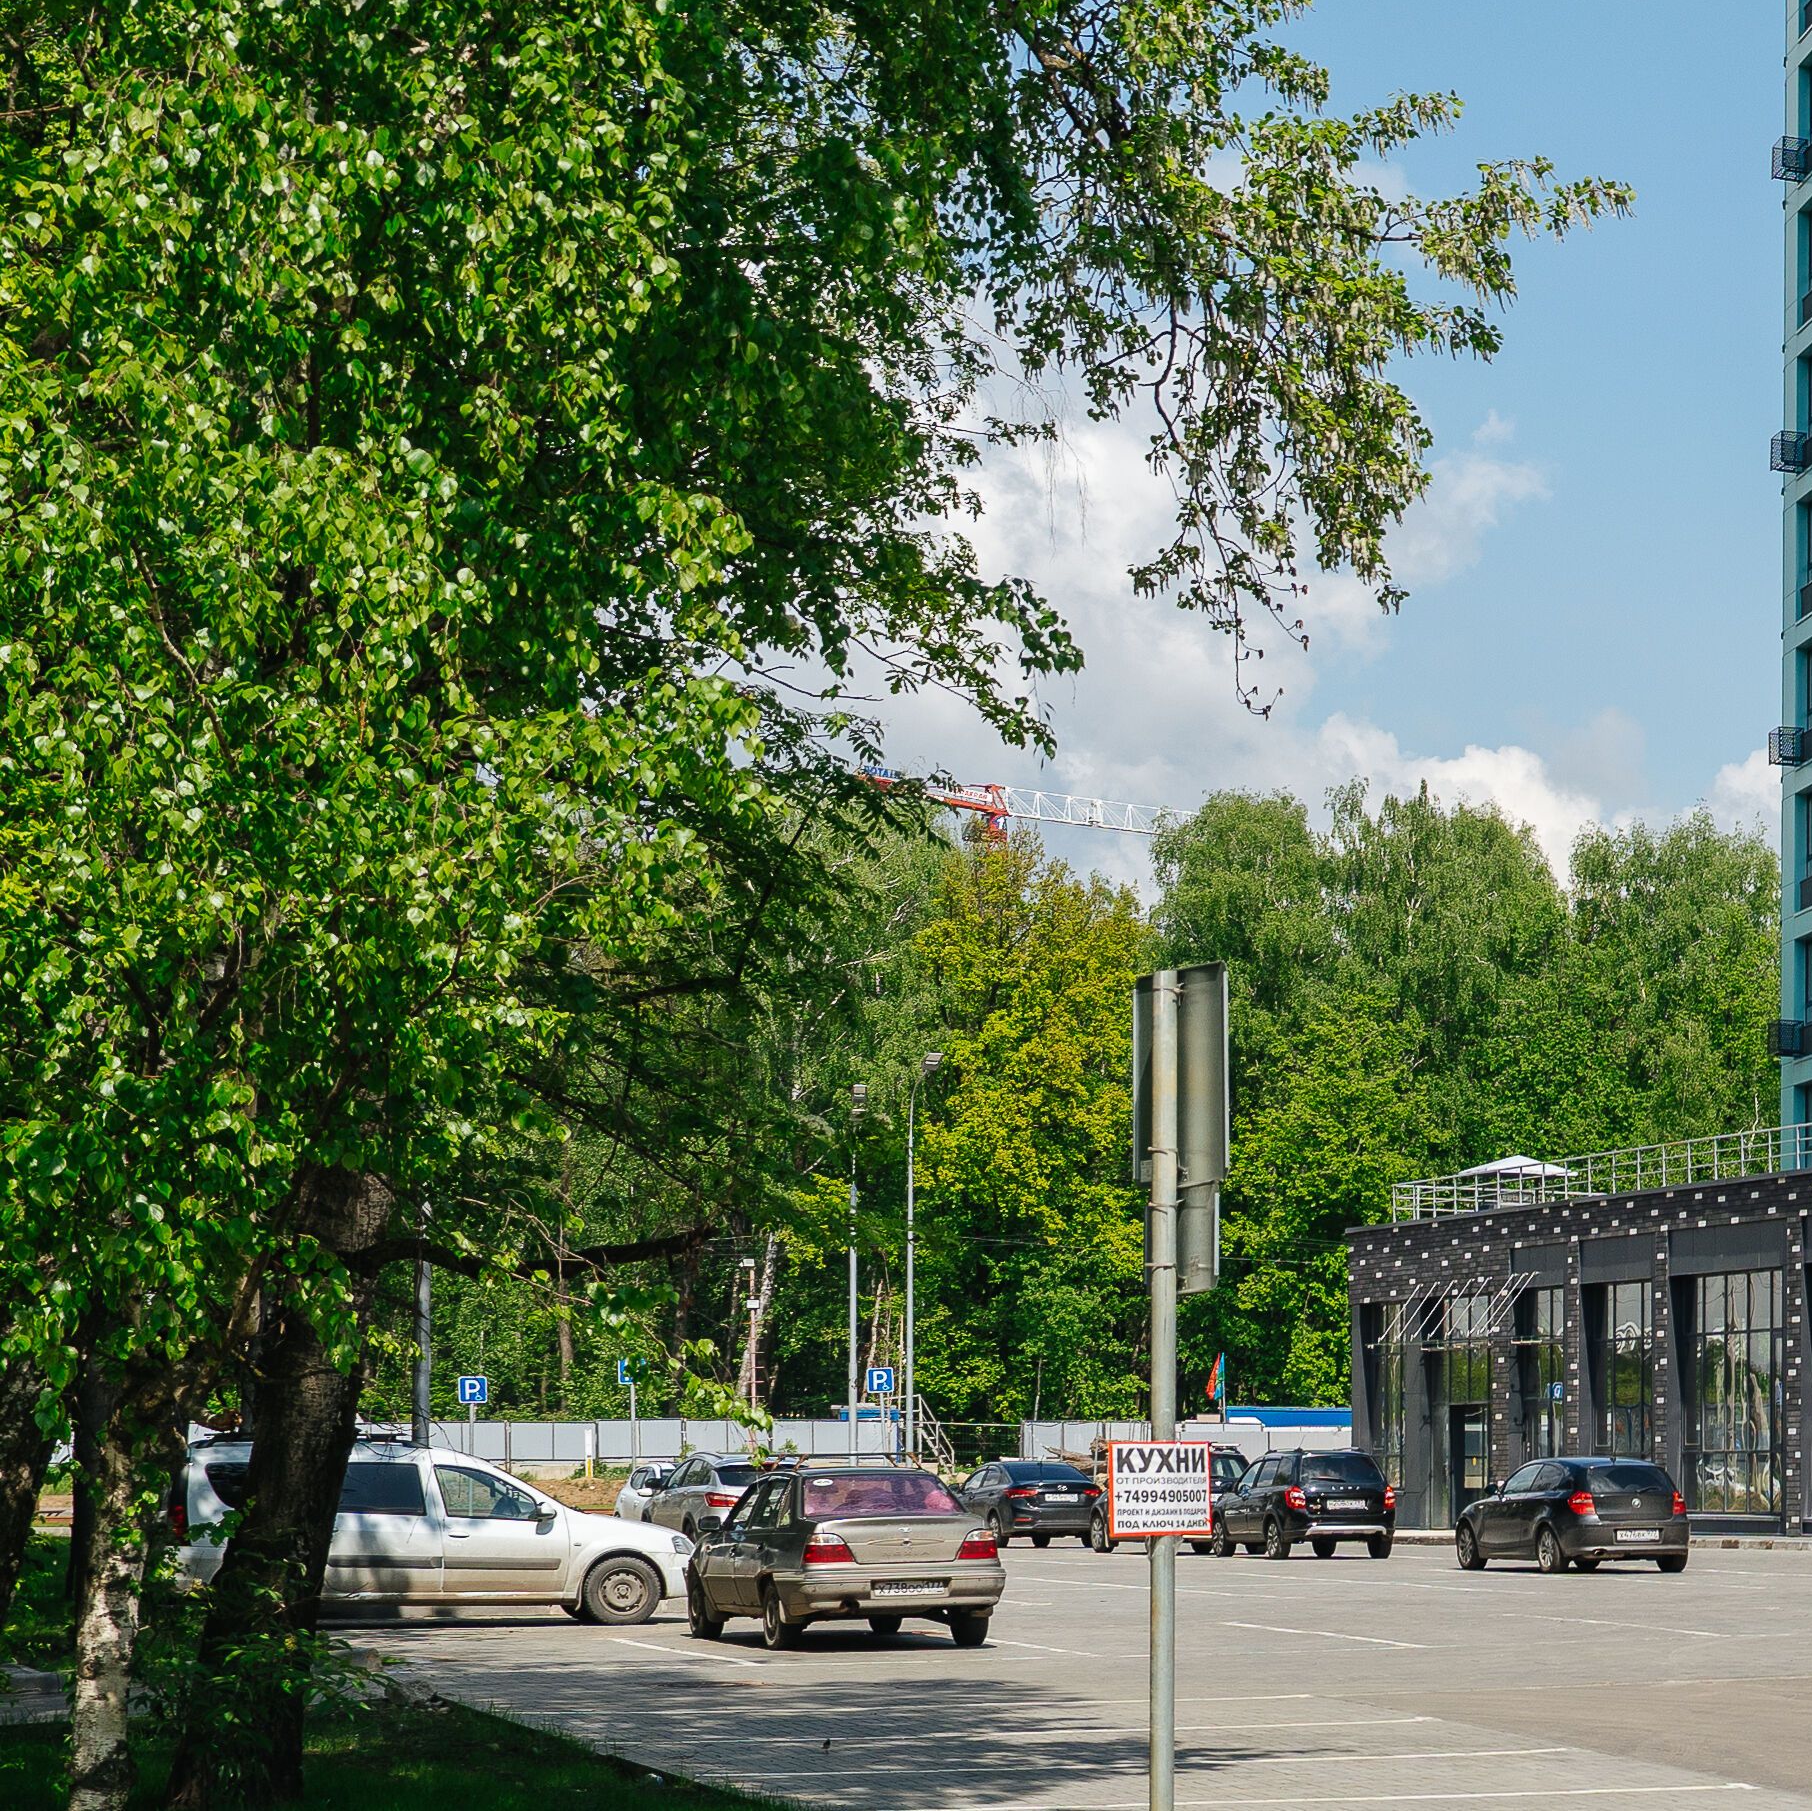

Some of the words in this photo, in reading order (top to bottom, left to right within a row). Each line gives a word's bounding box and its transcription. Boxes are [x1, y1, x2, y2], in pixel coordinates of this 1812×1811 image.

[872, 1370, 888, 1391] P
[465, 1379, 481, 1400] P
[1116, 1447, 1206, 1473] КУХНИ
[1116, 1477, 1130, 1485] ОТ
[1132, 1476, 1207, 1486] ПРОИЗВОДИТЕЛЯ
[1115, 1489, 1207, 1503] +74994905007
[1117, 1508, 1144, 1516] ПРОЕКТ
[1183, 1508, 1207, 1516] ПОДАРОК
[1117, 1520, 1140, 1529] ПОД
[1142, 1520, 1174, 1528] КЛЮЧ
